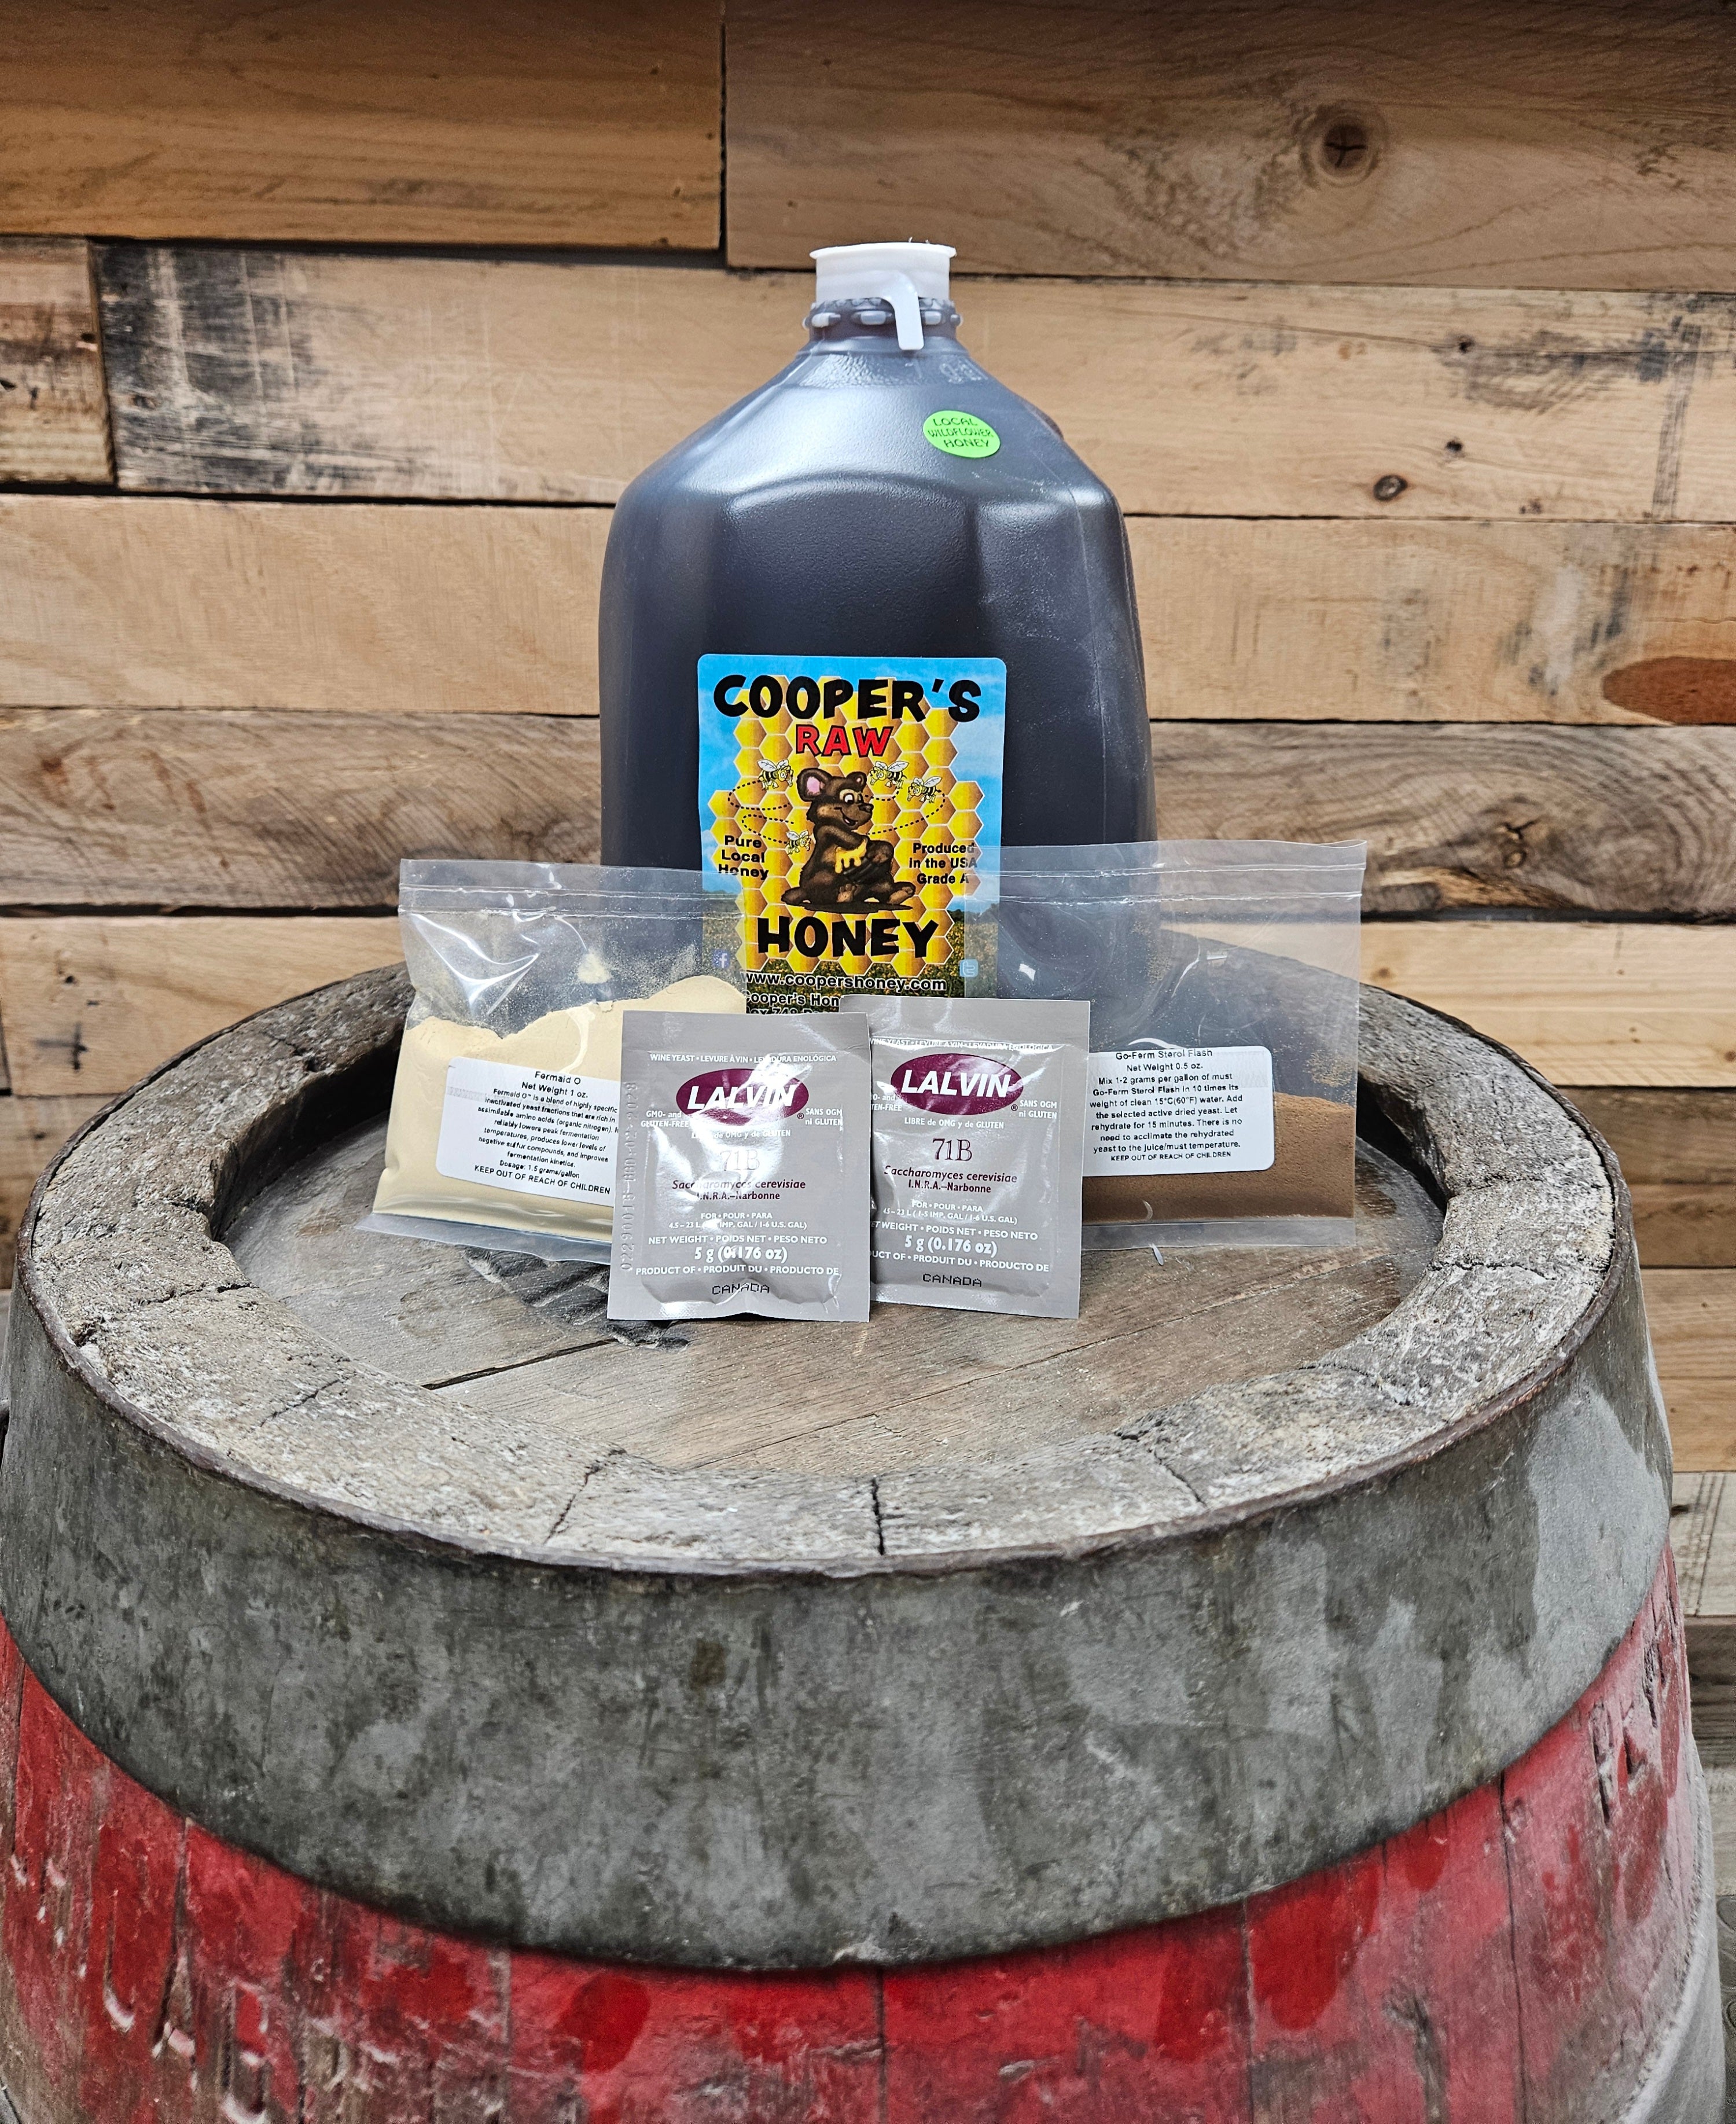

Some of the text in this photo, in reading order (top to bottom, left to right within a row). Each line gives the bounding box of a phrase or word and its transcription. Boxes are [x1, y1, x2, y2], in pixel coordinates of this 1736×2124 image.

[933, 418, 978, 426] LOCAL
[928, 428, 994, 438] WILDFLOWER
[944, 439, 989, 447] HONEY
[713, 674, 982, 722] COOPER'S
[796, 724, 894, 757] RAW
[724, 835, 762, 849] Pure
[913, 842, 974, 854] Produced
[721, 850, 765, 863] Local
[909, 857, 977, 869] in the USA
[718, 863, 769, 881] Honey
[917, 873, 969, 885] Grade A
[757, 917, 939, 958] HONEY
[740, 971, 947, 993] www.coopershoney.com
[810, 993, 840, 1006] Hon
[1116, 1052, 1154, 1060] Go-Ferm
[1158, 1049, 1185, 1058] Sterol
[1143, 1063, 1173, 1072] Weight
[535, 1071, 571, 1083] Fermaid
[1130, 1076, 1155, 1085] grams
[1174, 1074, 1198, 1083] gallon
[521, 1081, 535, 1090] Net
[539, 1084, 567, 1096] Weight
[901, 1070, 1011, 1098] LALVIN
[687, 1084, 797, 1110] LALVIN
[1089, 1100, 1117, 1108] weight
[646, 1110, 665, 1118] GMO-
[1028, 1110, 1057, 1119] GLUTEN
[1111, 1110, 1145, 1118] selected
[1198, 1108, 1222, 1116] yeast.
[641, 1120, 689, 1128] GLUTEN-FREE
[814, 1118, 843, 1126] GLUTEN
[939, 1119, 956, 1127] OMG
[976, 1120, 1003, 1129] GLUTEN
[1091, 1123, 1131, 1131] rehydrate
[932, 1138, 972, 1161] 71B
[499, 1159, 525, 1170] Dosage:
[539, 1166, 580, 1178] grams/gallon
[884, 1165, 1017, 1182] Saccharomyces cerevisiae
[475, 1164, 494, 1173] KEEP
[528, 1175, 555, 1185] REACH
[570, 1182, 610, 1194] CHILDREN
[755, 1179, 806, 1189] cerevisiae
[998, 1216, 1017, 1225] GAL)
[882, 1221, 918, 1231] WEIGHT
[926, 1225, 954, 1234] POIDS
[957, 1227, 976, 1236] NET
[984, 1229, 1008, 1237] PESO
[1010, 1231, 1038, 1240] NETO
[648, 1236, 667, 1244] NET
[669, 1235, 708, 1243] WEIGHT
[716, 1235, 744, 1243] POIDS
[800, 1236, 827, 1244] NETO
[904, 1234, 996, 1258] 5 g (0.176 oz)
[694, 1247, 702, 1259] 5
[706, 1248, 713, 1263] g
[765, 1247, 787, 1263] oz)
[913, 1254, 955, 1265] PRODUIT
[957, 1258, 972, 1266] DU
[980, 1259, 1033, 1270] PRODUCTO
[1036, 1263, 1049, 1272] DE
[635, 1266, 681, 1275] PRODUCT
[703, 1265, 746, 1273] PRODUIT
[770, 1266, 823, 1274] PRODUCTO
[826, 1267, 839, 1275] DE
[922, 1273, 981, 1287] CANADA
[712, 1283, 770, 1295] CANADA
